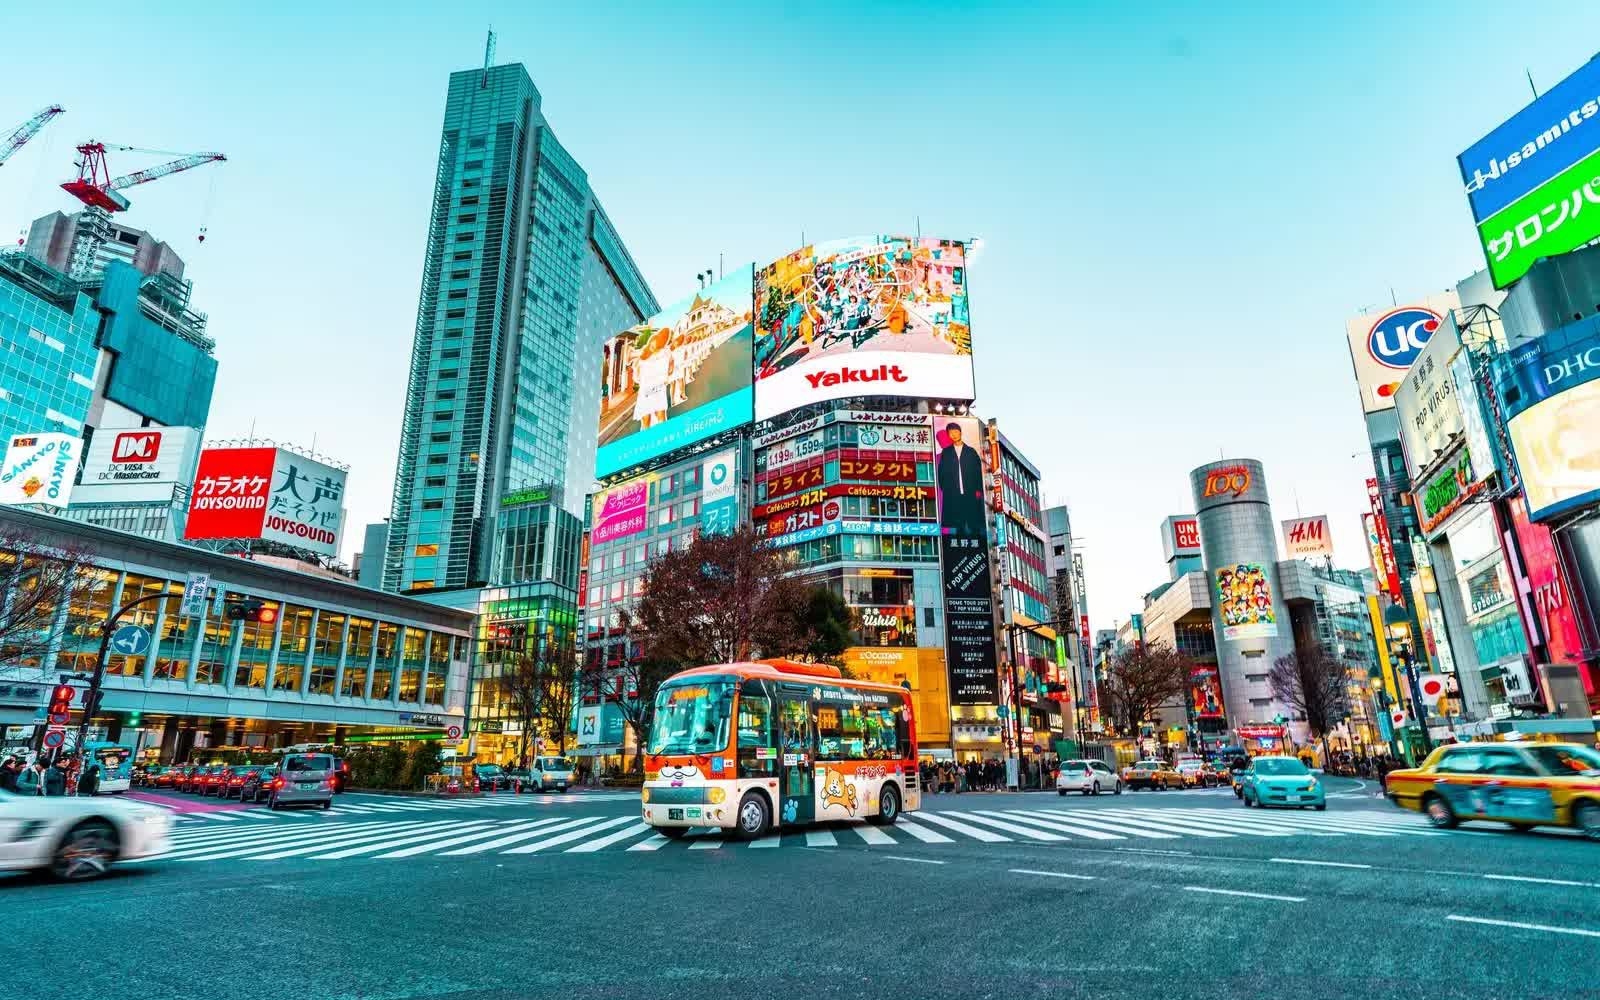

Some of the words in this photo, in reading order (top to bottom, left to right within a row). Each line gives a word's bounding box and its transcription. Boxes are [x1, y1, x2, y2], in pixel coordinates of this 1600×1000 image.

[1465, 96, 1600, 194] Hisamits
[804, 364, 908, 390] Yakult
[1544, 347, 1600, 385] DHC
[1428, 380, 1450, 413] VIRUS
[116, 435, 155, 458] DC
[883, 430, 929, 444] しゃぶ葉
[2, 442, 55, 483] SANKYO
[47, 440, 73, 499] SANKYO
[108, 463, 122, 472] DC
[124, 463, 143, 471] VISA
[756, 455, 767, 466] 9F
[840, 462, 914, 477] コンタクト
[98, 472, 113, 480] DC
[113, 471, 161, 480] MasterCard
[197, 475, 267, 496] カラオケ
[273, 464, 344, 504] 大声
[1203, 473, 1249, 498] 109
[194, 496, 265, 510] JOYSOUND
[799, 488, 828, 507] ガスト
[893, 486, 928, 500] ガスト
[269, 495, 337, 531] だそうぜ
[785, 510, 820, 533] ガスト
[265, 514, 335, 545] JOYSOUND
[756, 524, 767, 536] 7F
[873, 523, 938, 533] 英会話イーオン
[1289, 519, 1323, 544] H&M
